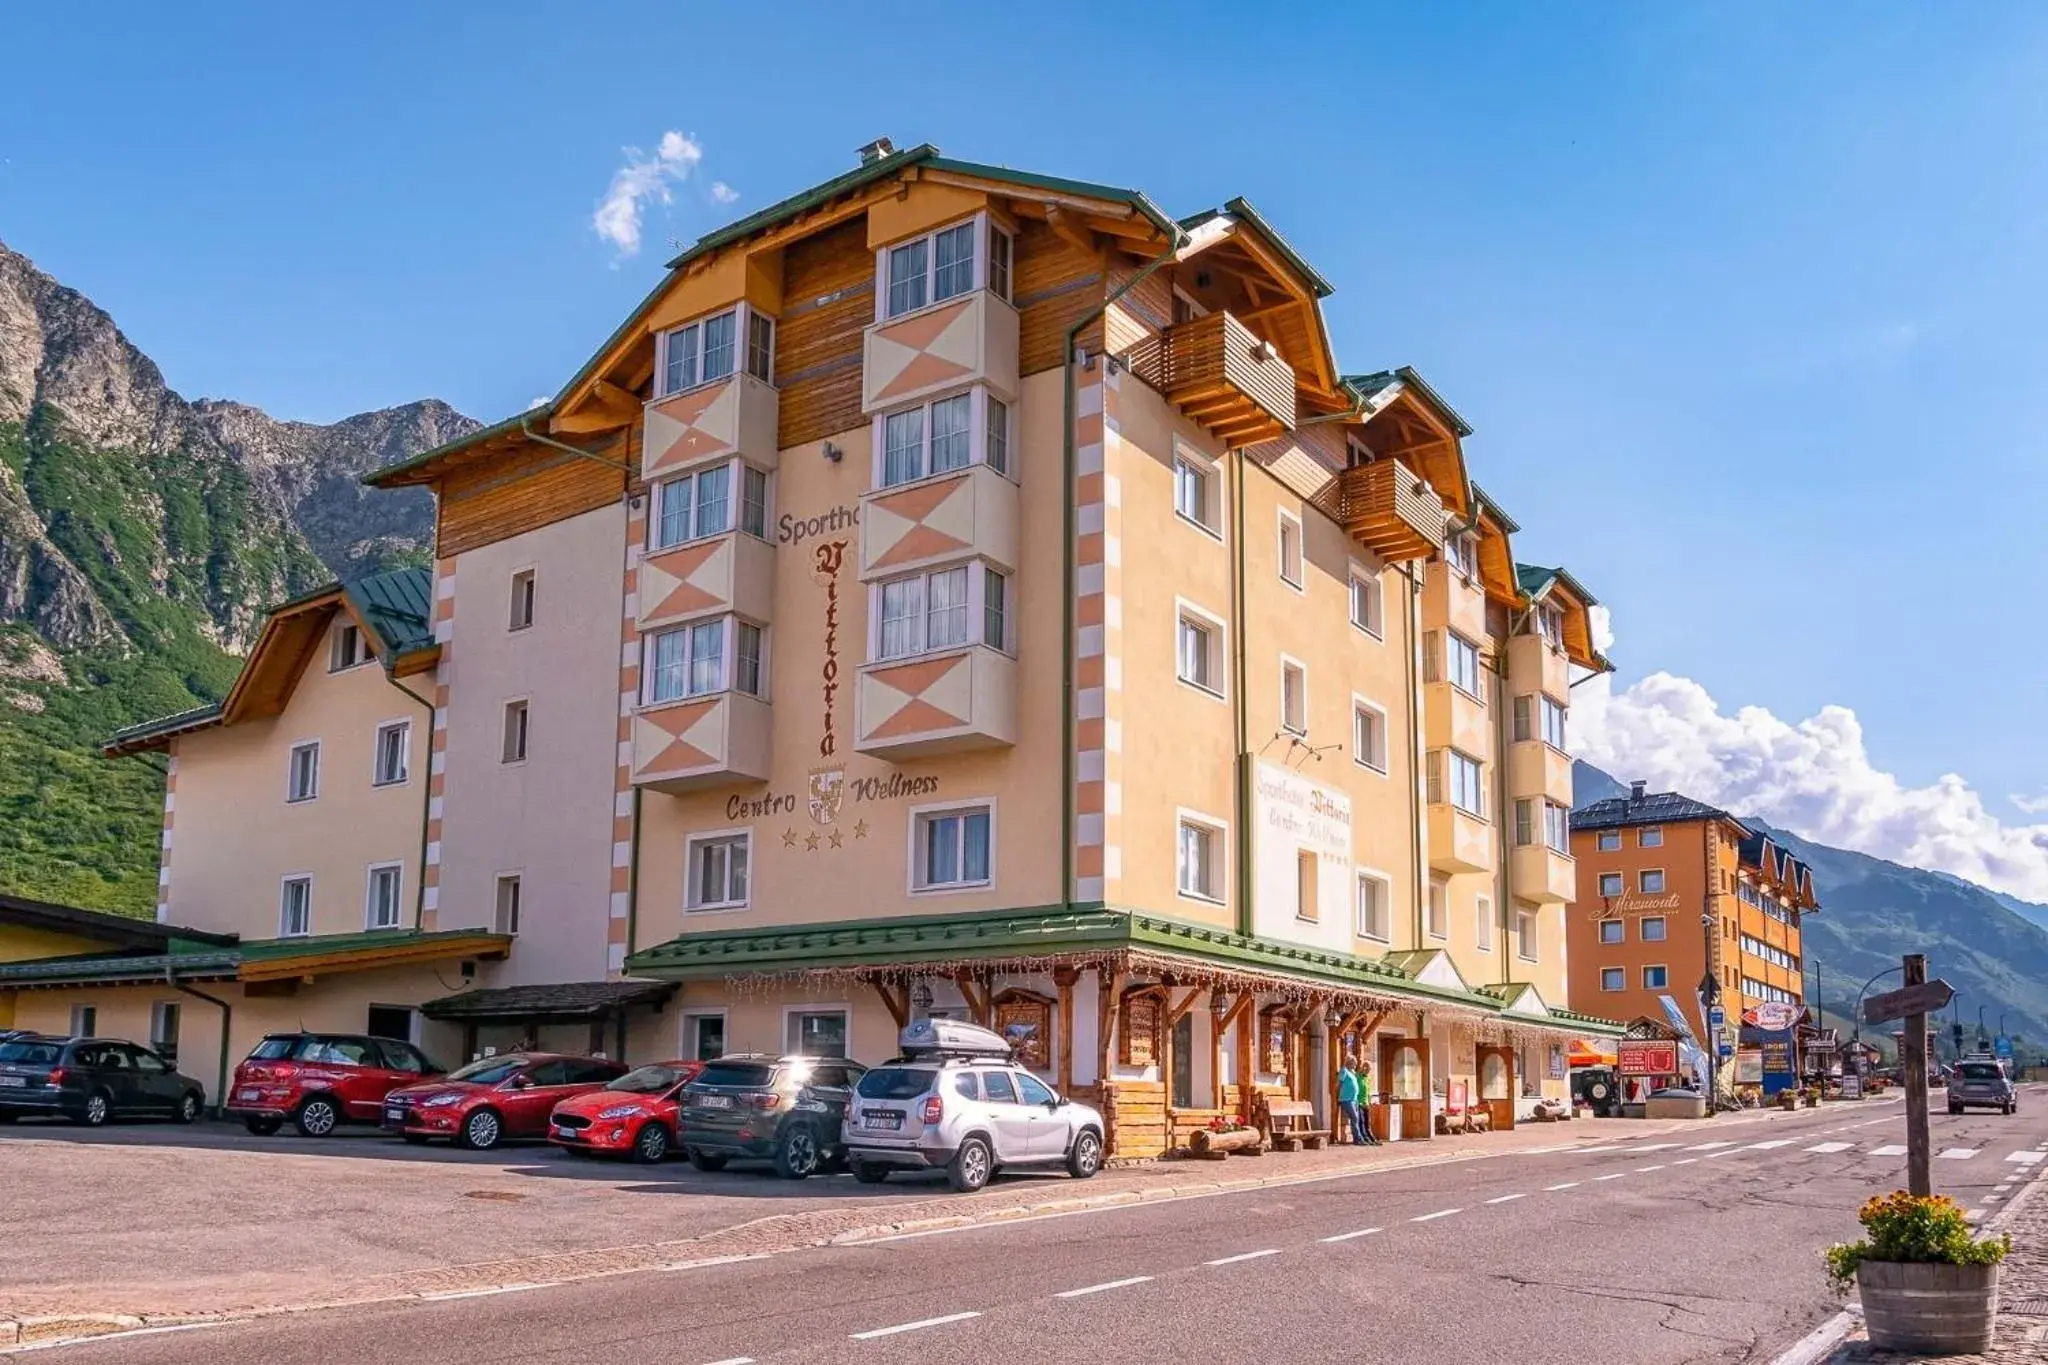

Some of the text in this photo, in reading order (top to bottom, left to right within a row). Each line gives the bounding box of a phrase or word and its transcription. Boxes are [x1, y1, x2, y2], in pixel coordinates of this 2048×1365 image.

[816, 541, 849, 759] Vittoria
[726, 773, 940, 822] Centro Wellness
[1590, 886, 1682, 921] Miramonti
